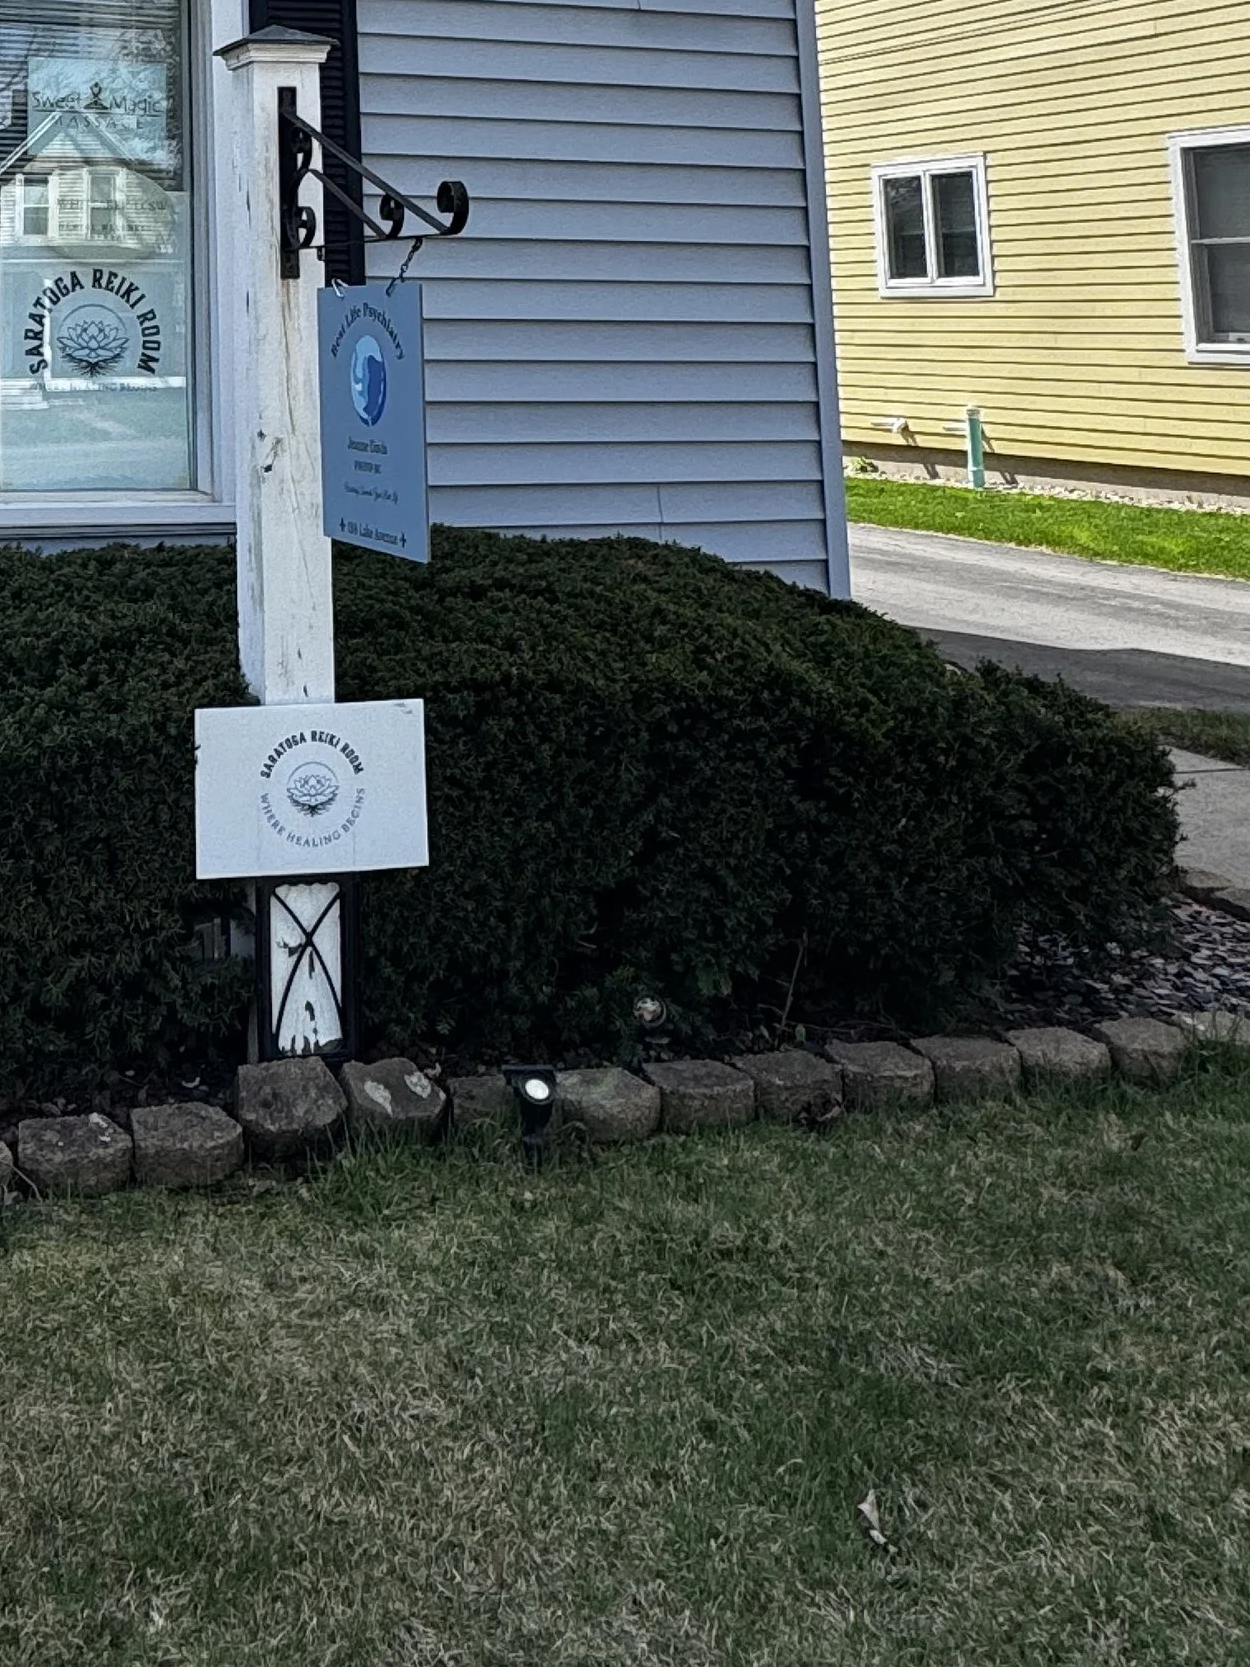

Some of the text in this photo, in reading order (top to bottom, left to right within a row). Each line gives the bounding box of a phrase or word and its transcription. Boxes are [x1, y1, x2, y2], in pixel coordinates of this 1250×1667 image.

[110, 95, 162, 118] Magic
[24, 268, 162, 375] SARATOGA REIKI ROOM
[260, 730, 365, 779] SARATOGA REIKI ROOM
[260, 787, 366, 848] WHERE HEALING BEGINS
